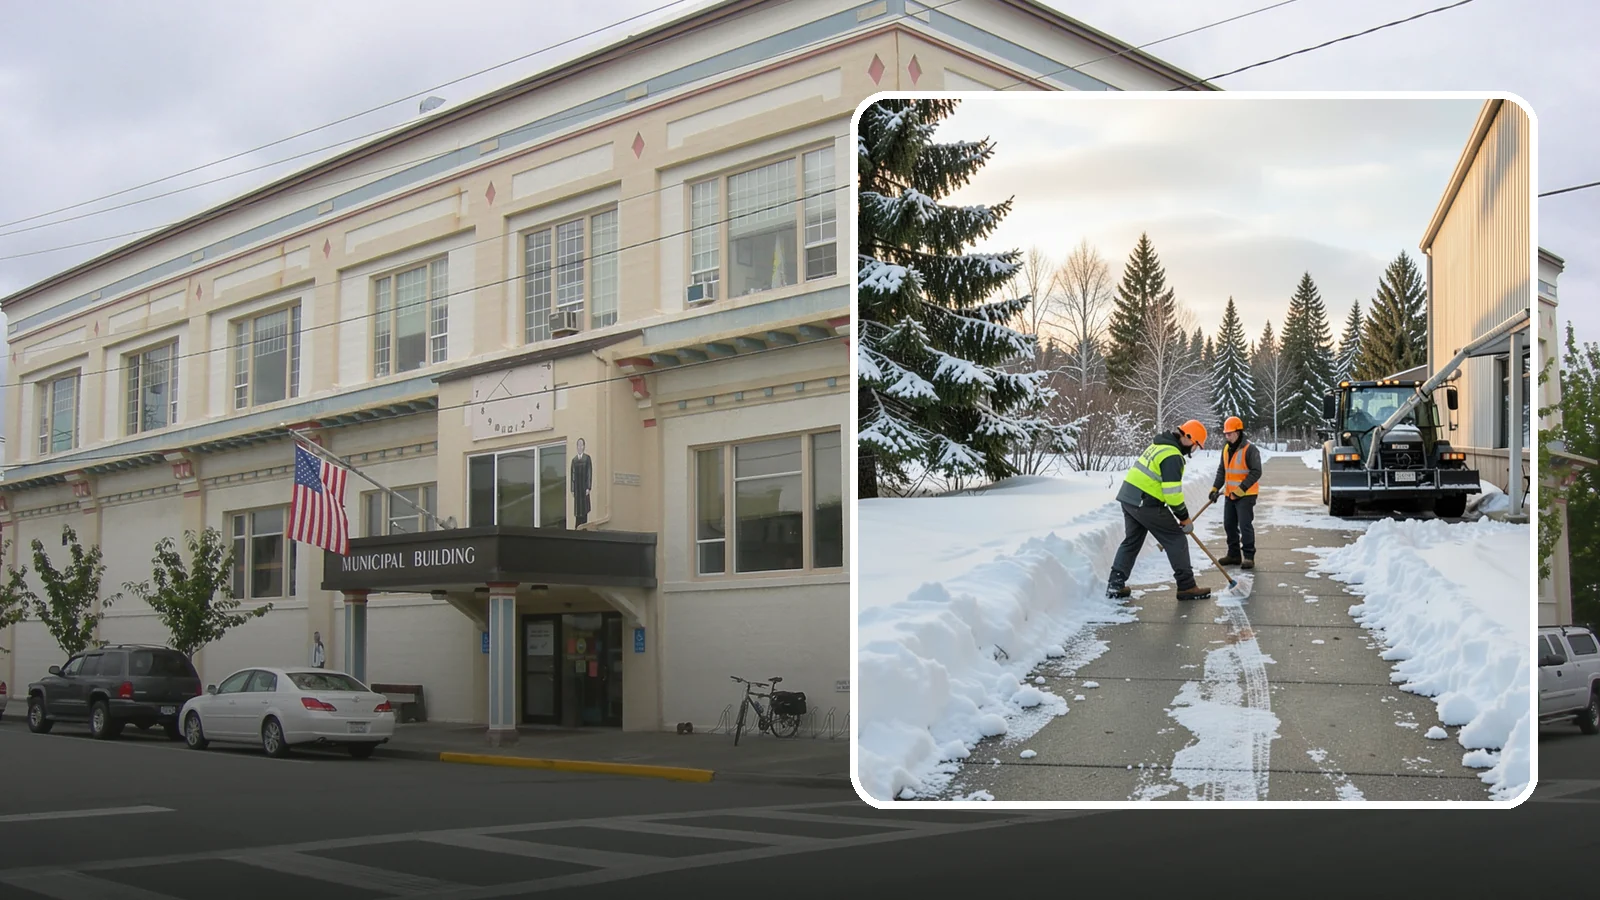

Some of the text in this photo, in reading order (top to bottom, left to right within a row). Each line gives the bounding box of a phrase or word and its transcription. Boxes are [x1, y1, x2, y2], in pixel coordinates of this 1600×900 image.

[481, 407, 485, 415] 8
[487, 417, 492, 426] 9
[494, 423, 500, 431] 10
[342, 546, 475, 572] MUNICIPAL BUILDING
